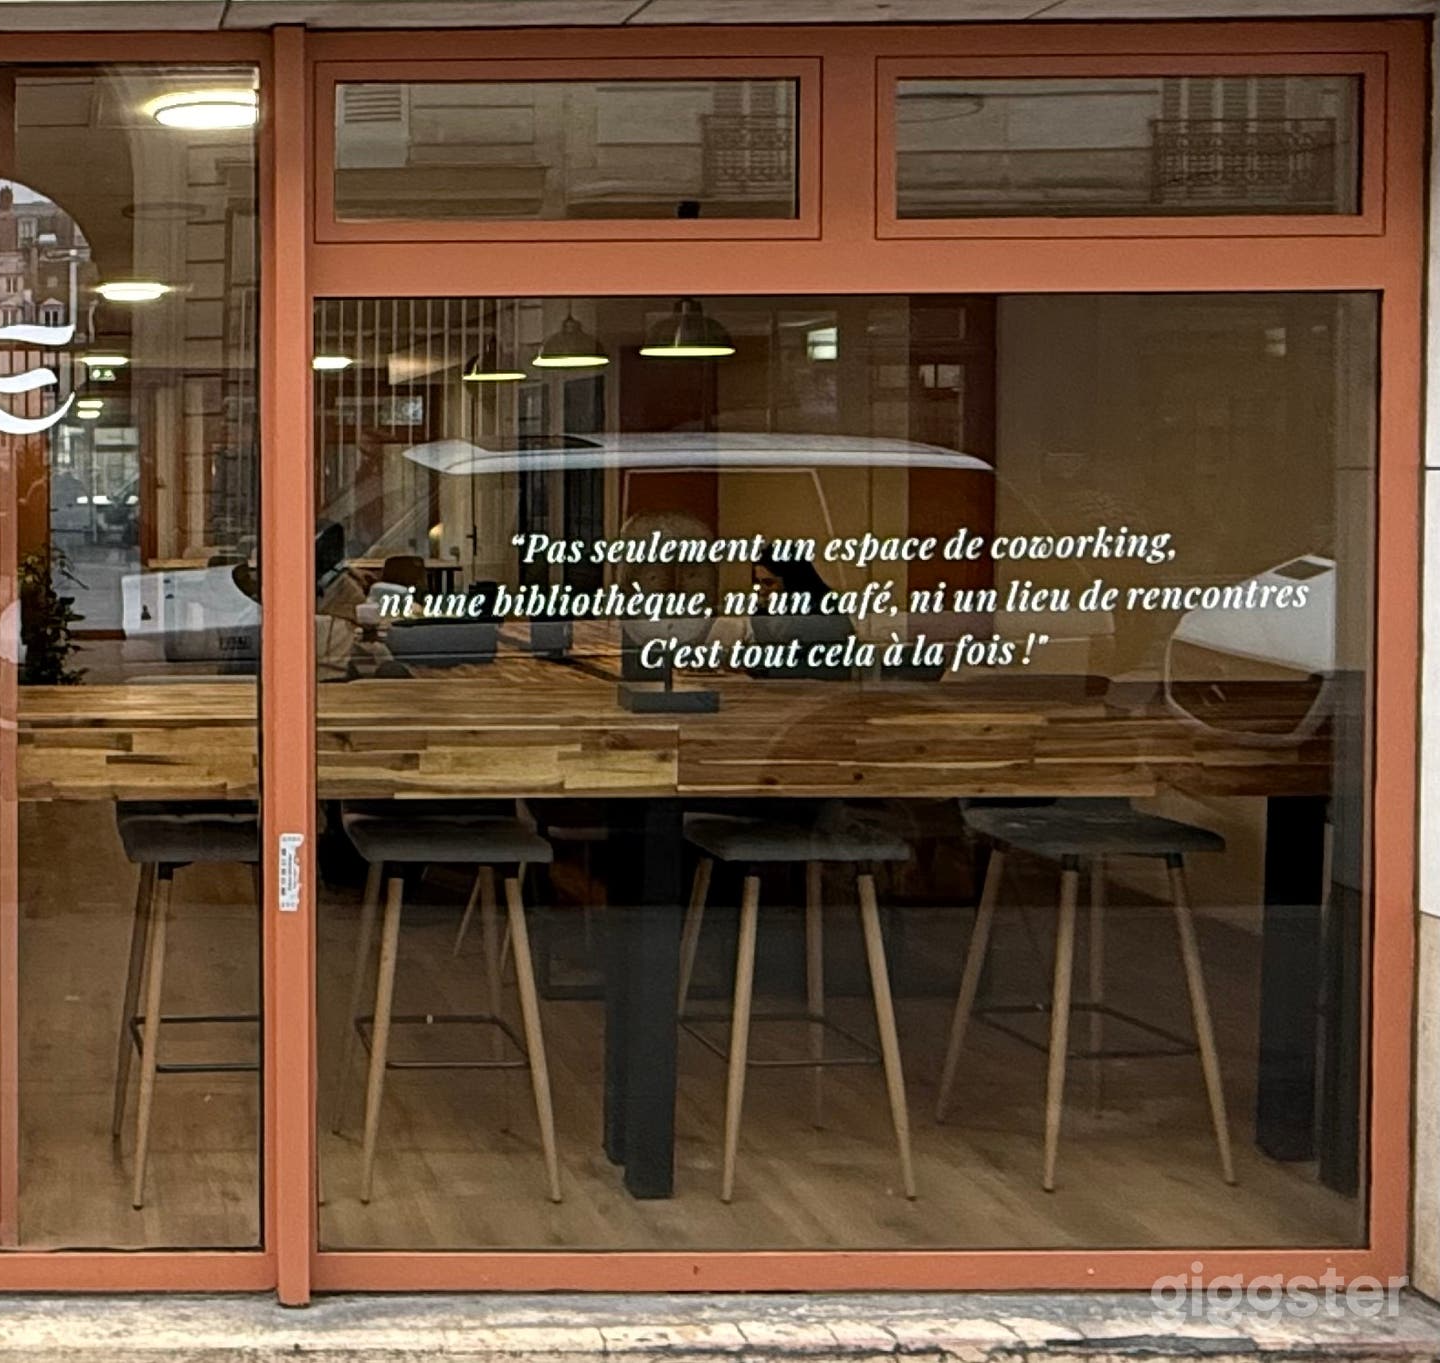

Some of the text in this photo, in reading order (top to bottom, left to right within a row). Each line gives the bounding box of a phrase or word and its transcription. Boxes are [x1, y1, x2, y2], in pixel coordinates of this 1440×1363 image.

[511, 526, 1176, 567] “Pas seulement un espace de coworking,
[379, 579, 1311, 621] ni une bibliothèque, ni un café, ni un lieu de rencontres
[640, 637, 722, 668] C'est
[729, 639, 801, 668] tout
[807, 634, 876, 668] cela
[882, 631, 905, 667] à
[911, 633, 945, 667] la
[951, 633, 1016, 672] fois
